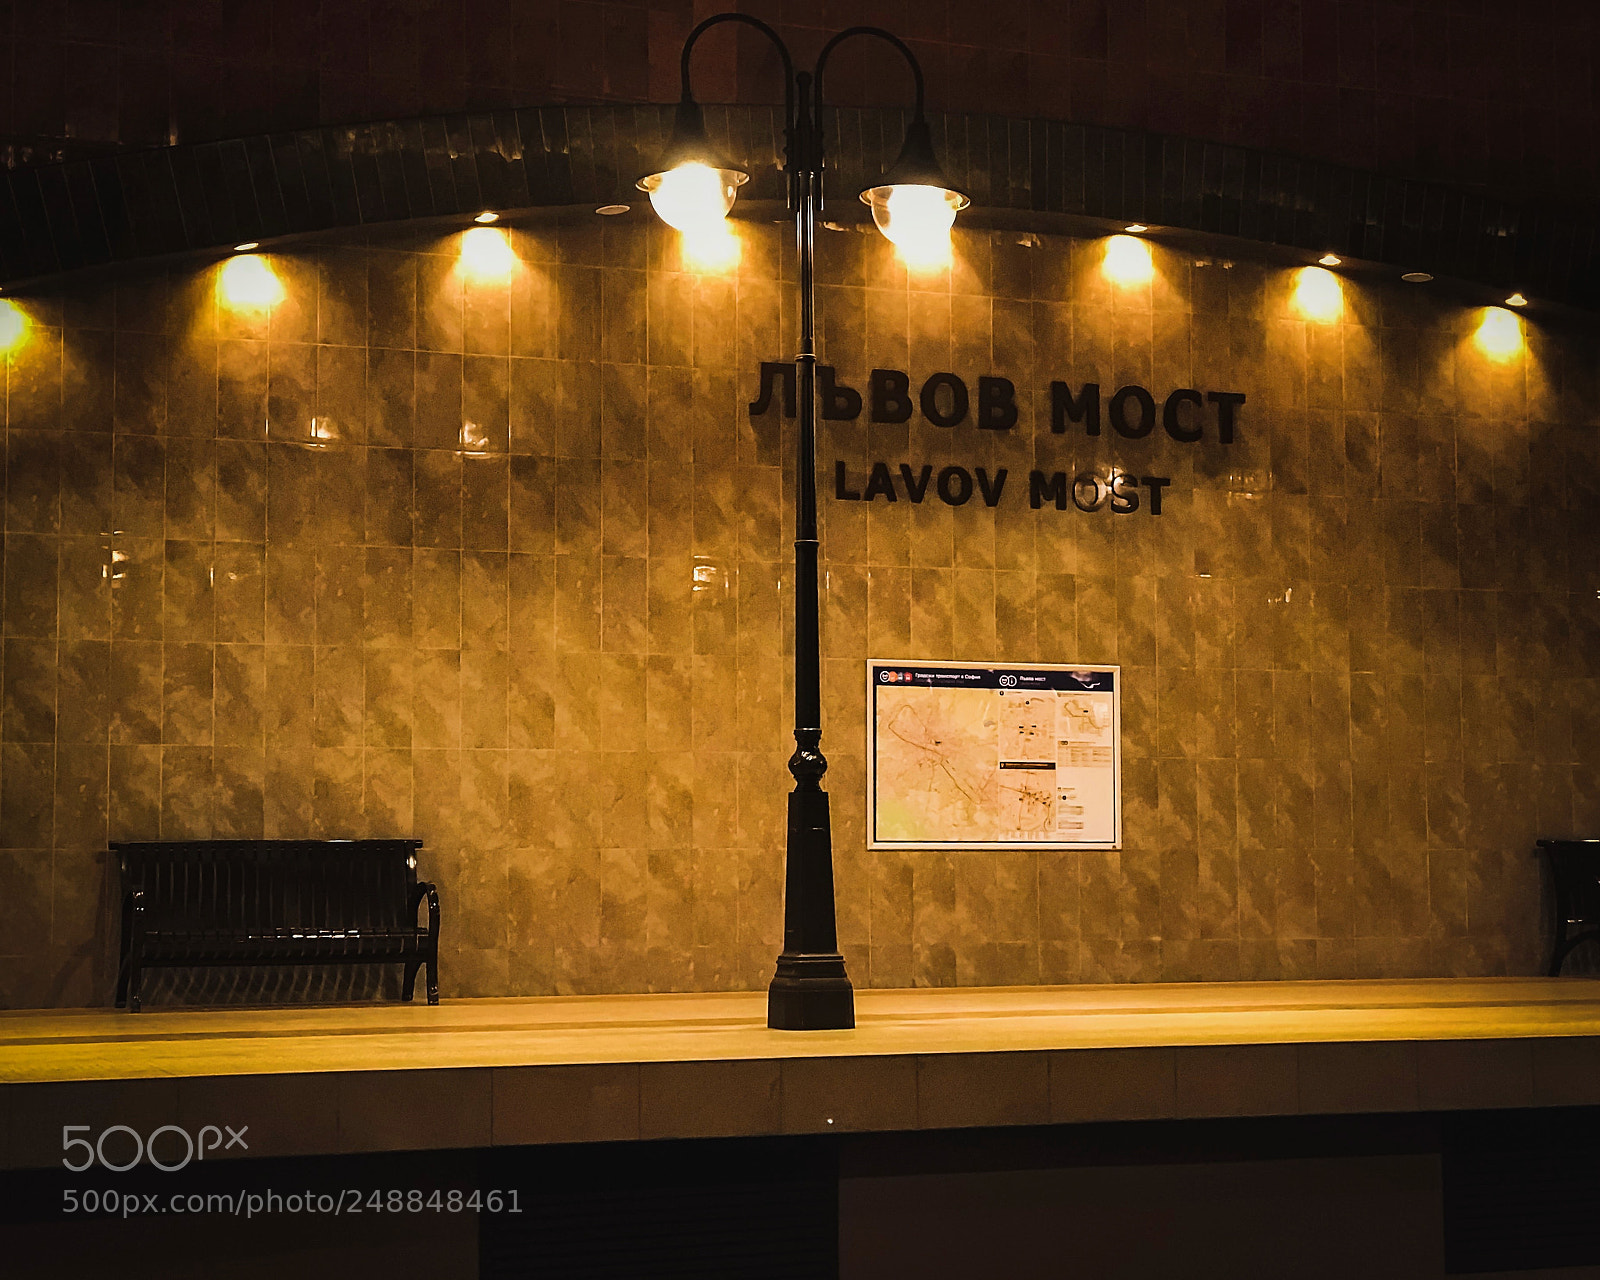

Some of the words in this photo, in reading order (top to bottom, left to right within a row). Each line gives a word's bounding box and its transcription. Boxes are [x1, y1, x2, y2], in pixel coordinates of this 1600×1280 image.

[749, 361, 1018, 430] ЛЪВОВ
[1051, 380, 1246, 444] МОСТ
[835, 460, 1008, 508] LAVOV
[1029, 469, 1171, 516] MOST
